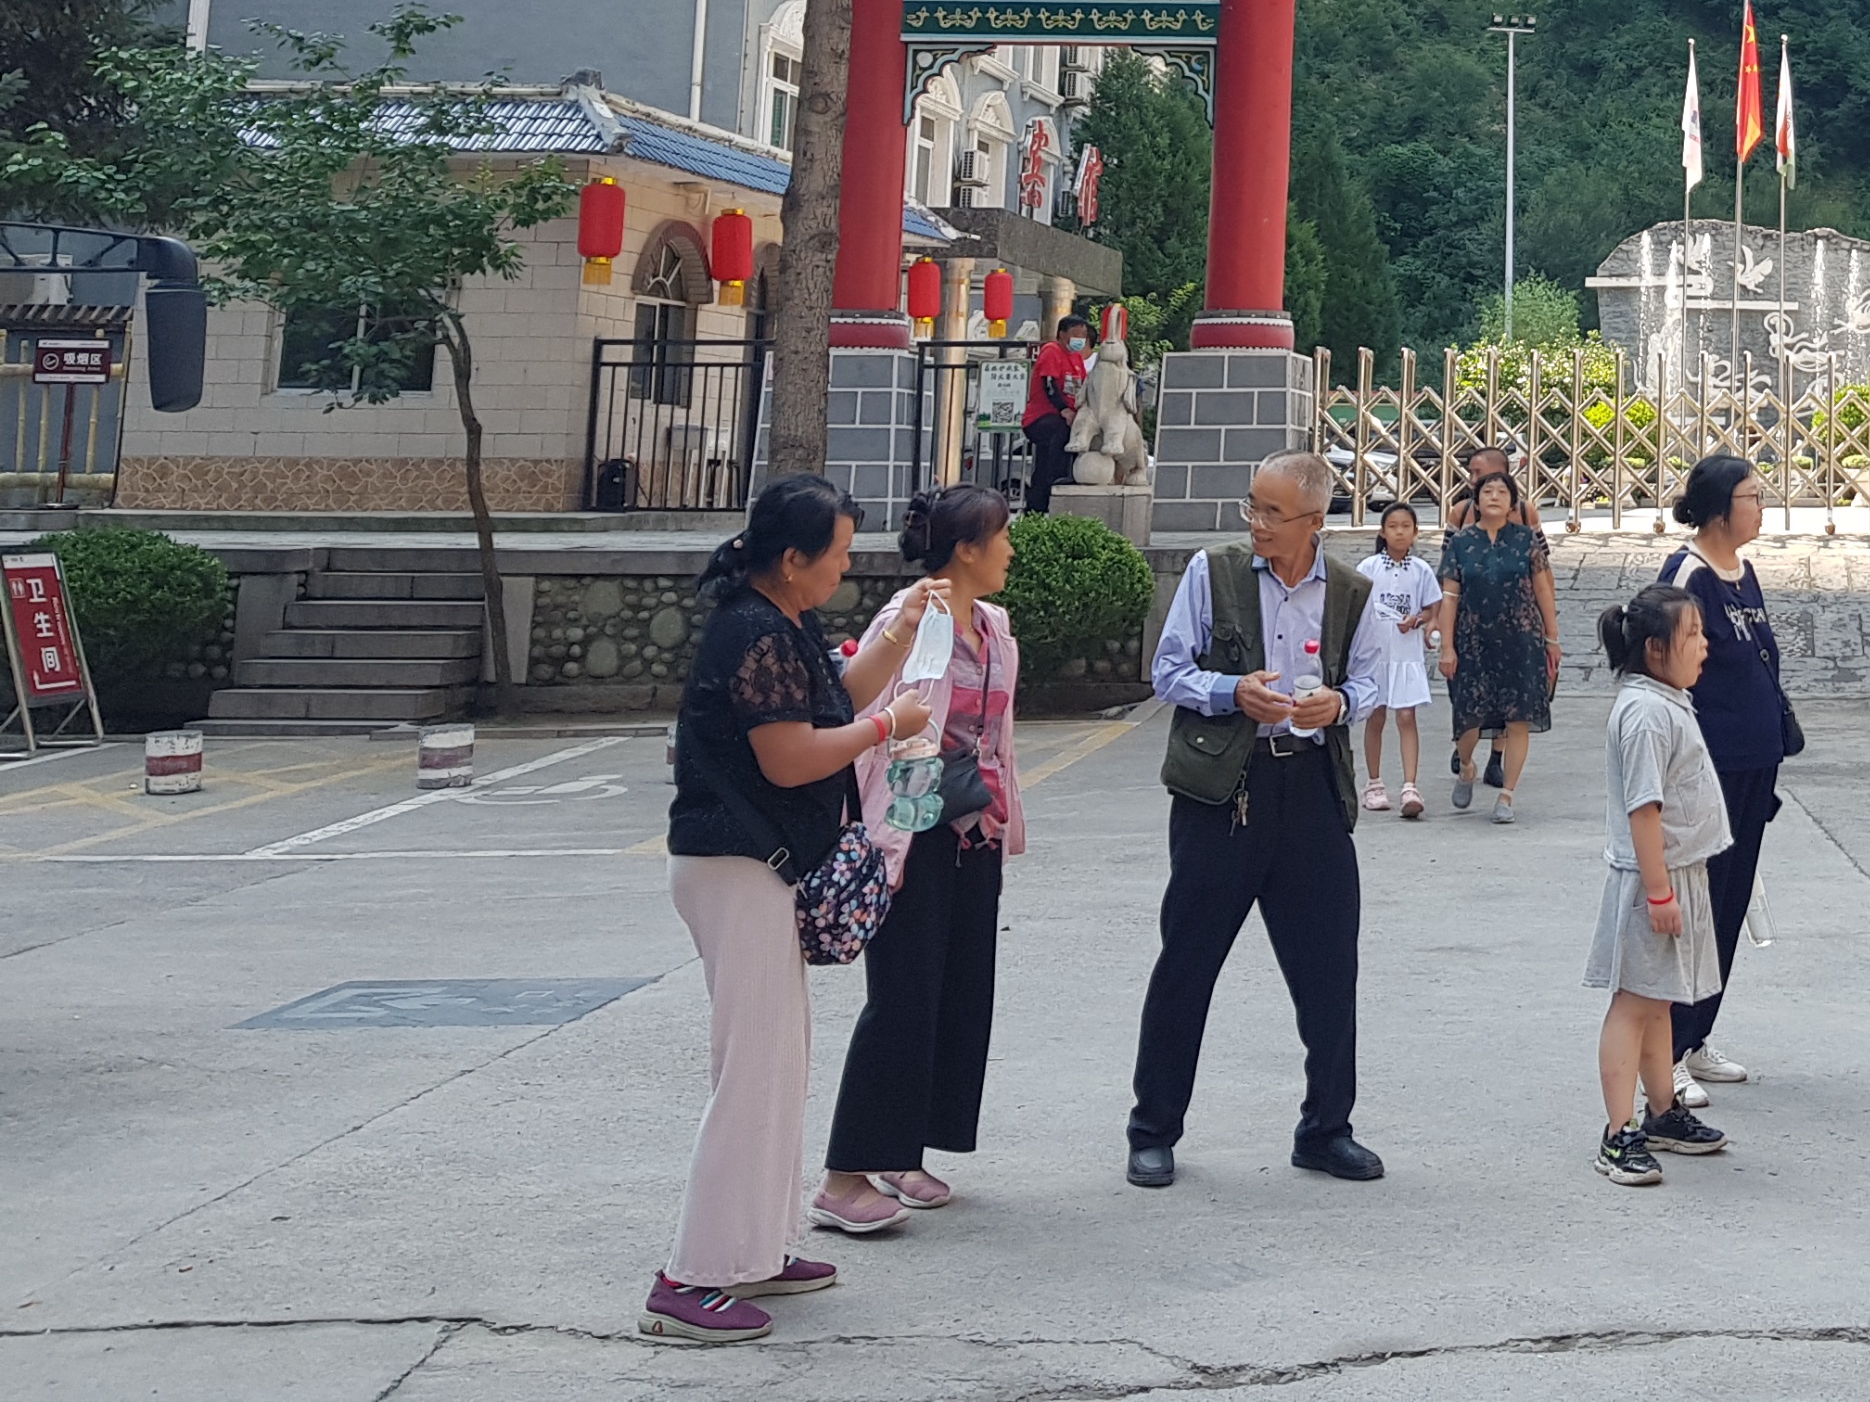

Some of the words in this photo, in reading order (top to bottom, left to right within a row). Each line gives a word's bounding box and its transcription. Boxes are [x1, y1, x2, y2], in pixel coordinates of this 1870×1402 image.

[63, 353, 102, 365] 吸烟区
[26, 578, 62, 673] 卫生间
